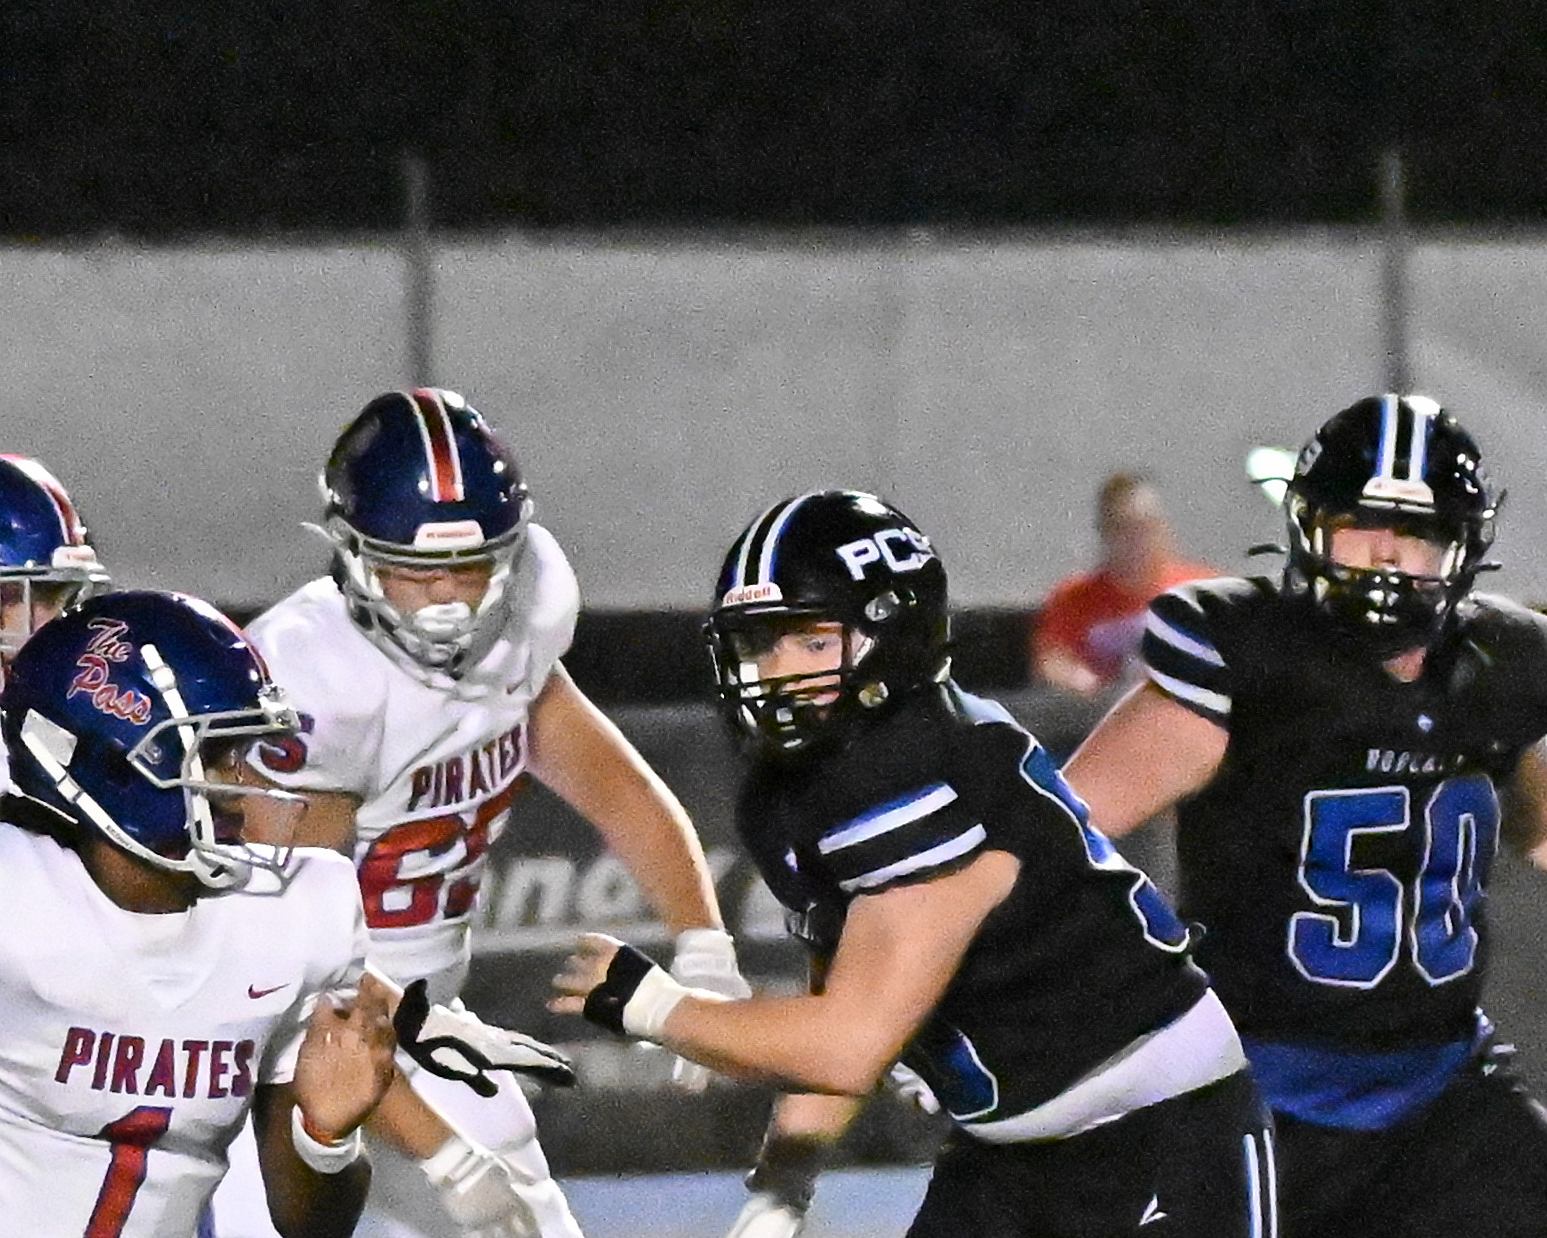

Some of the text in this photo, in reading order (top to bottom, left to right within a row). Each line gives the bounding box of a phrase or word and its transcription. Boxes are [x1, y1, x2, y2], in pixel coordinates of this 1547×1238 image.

[87, 617, 133, 663] The
[66, 653, 152, 725] Pass
[1288, 772, 1502, 990] 50
[54, 1027, 256, 1099] PIRATES
